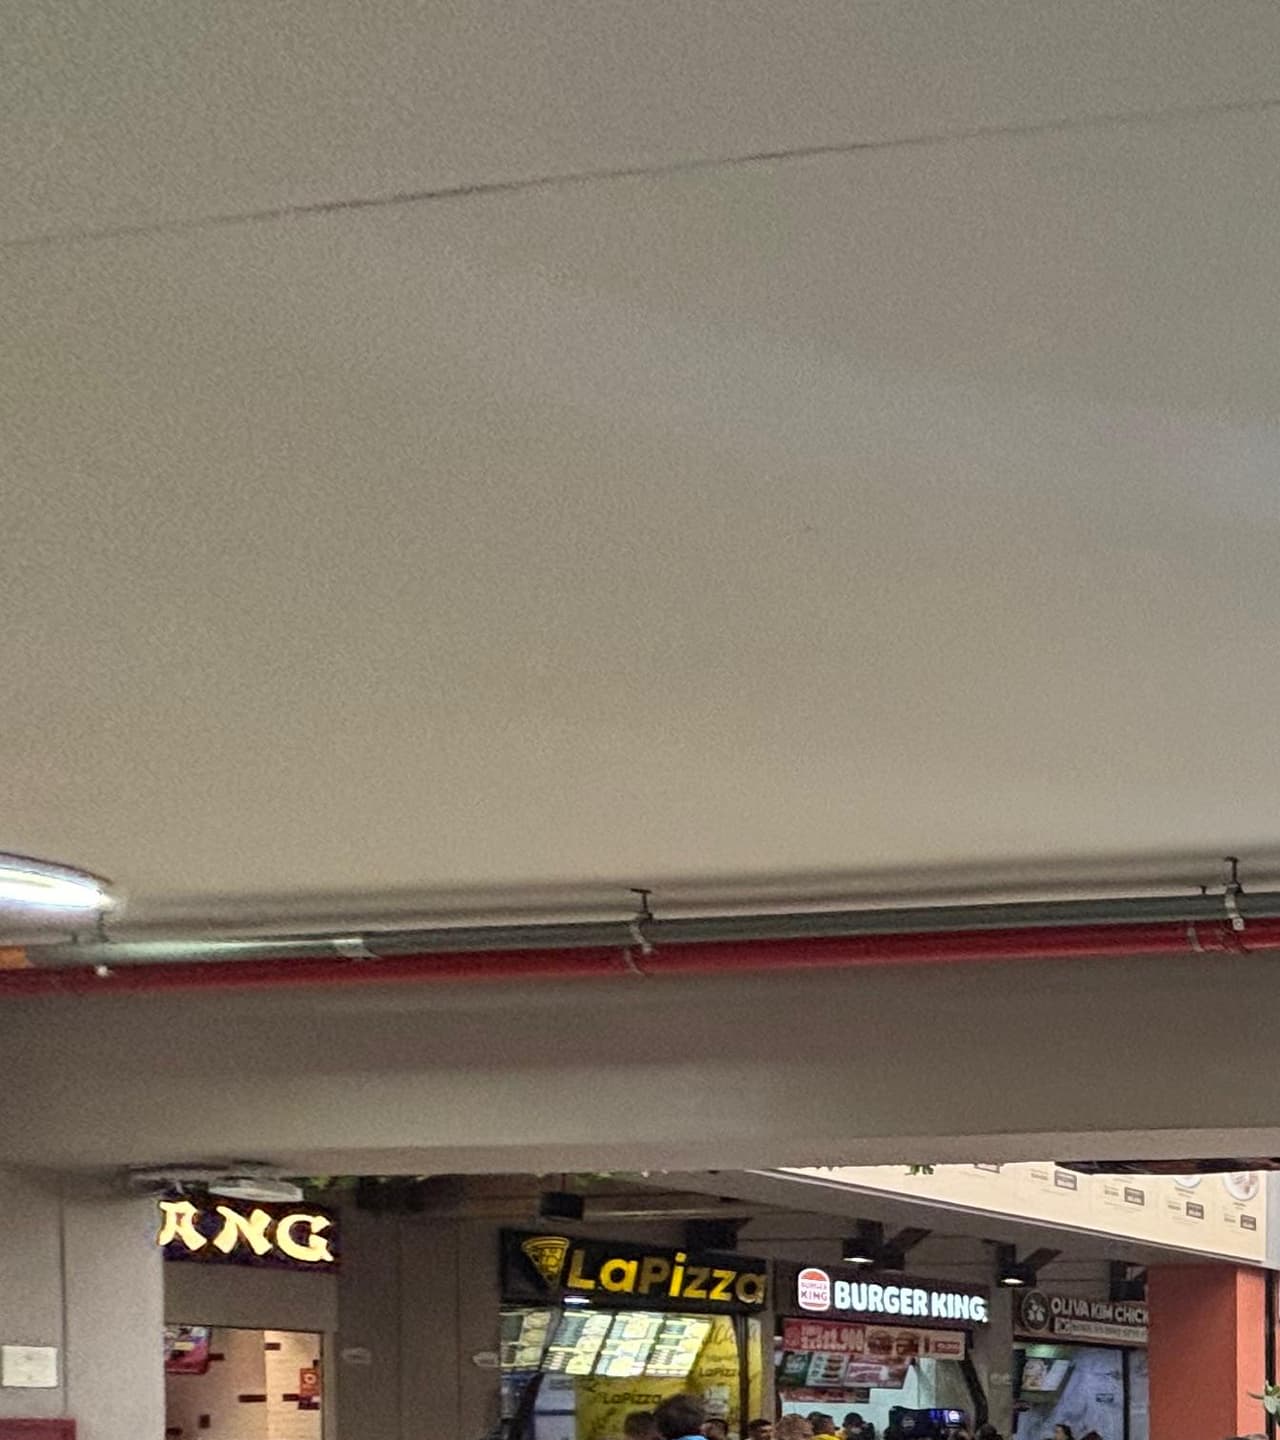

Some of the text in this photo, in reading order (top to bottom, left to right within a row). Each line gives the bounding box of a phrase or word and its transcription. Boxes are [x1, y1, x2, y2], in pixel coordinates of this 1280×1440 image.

[566, 1249, 767, 1305] LaPizza
[800, 1290, 828, 1301] KING
[834, 1280, 988, 1321] BURGER KING
[1051, 1297, 1090, 1318] OLIVA
